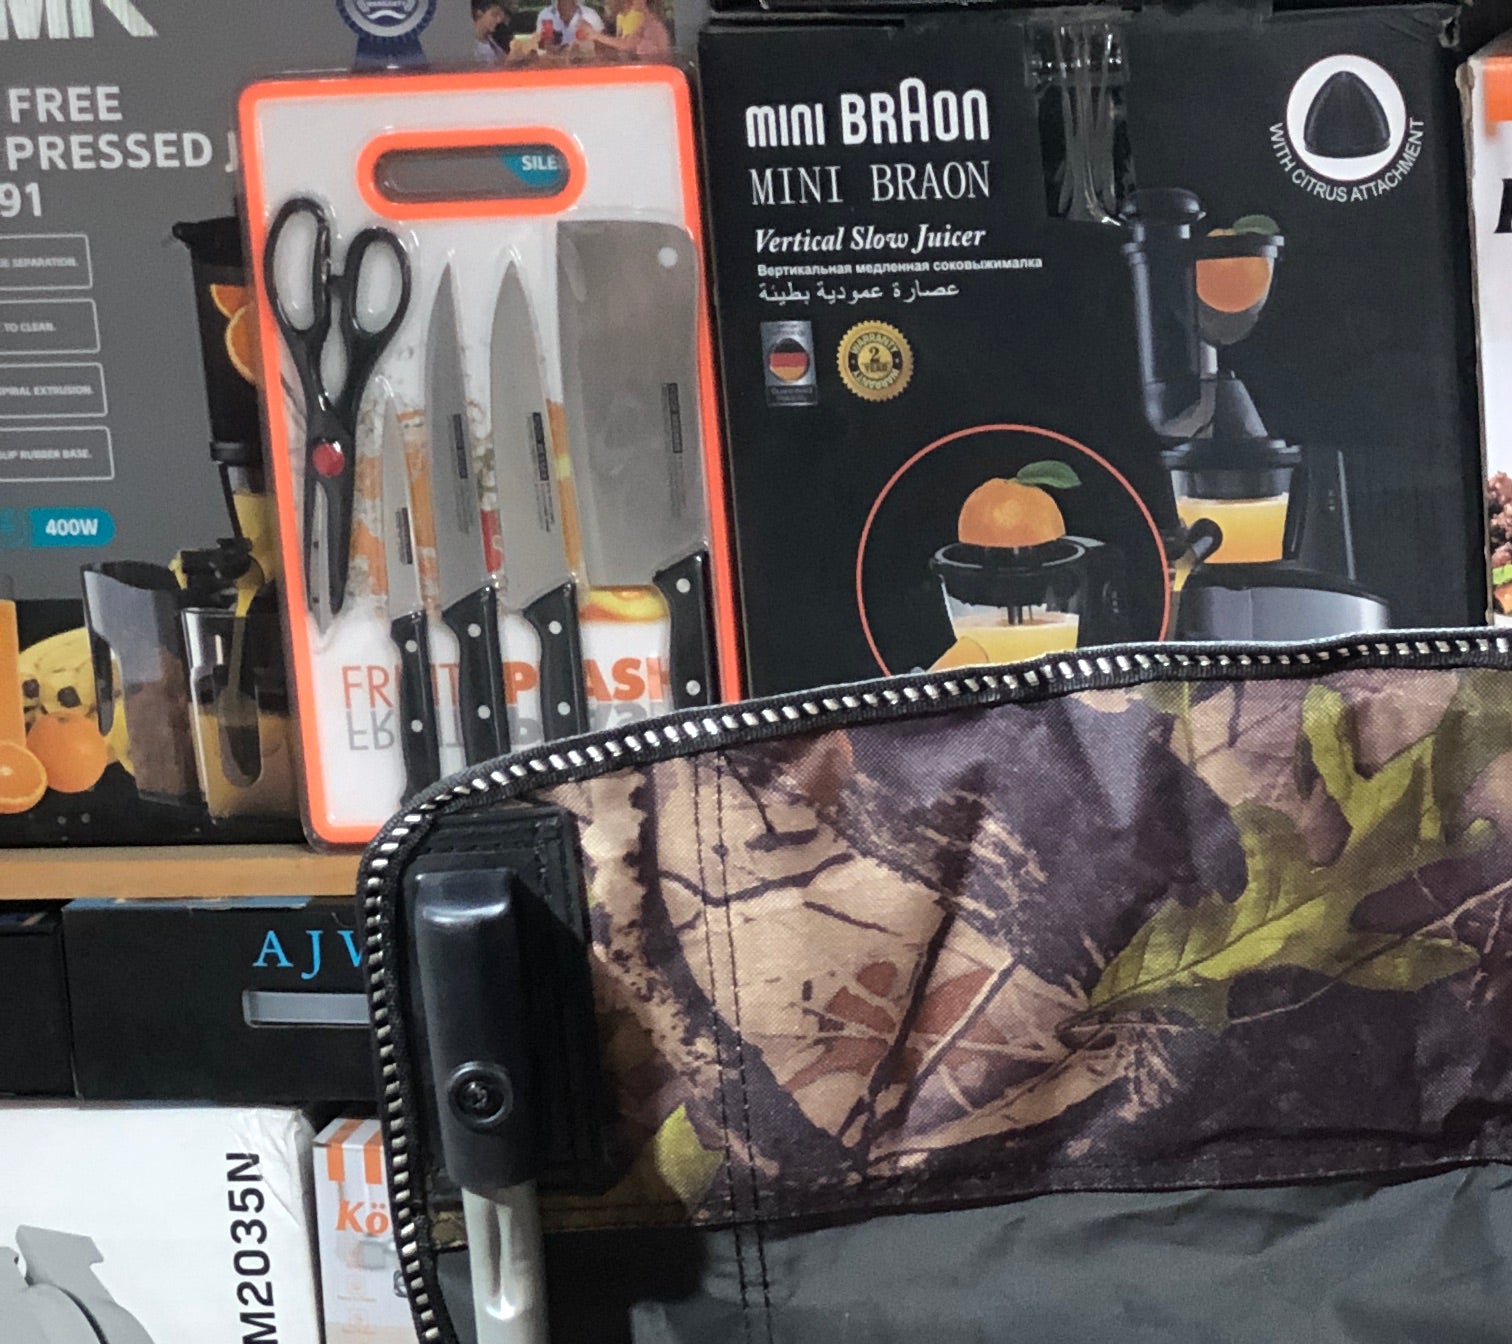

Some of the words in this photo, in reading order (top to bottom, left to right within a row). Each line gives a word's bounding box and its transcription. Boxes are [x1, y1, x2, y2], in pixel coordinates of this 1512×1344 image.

[8, 86, 122, 123] FREE
[6, 132, 212, 171] PRESSED
[1269, 122, 1293, 173] WITH
[1291, 168, 1347, 203] CITRUS
[1350, 117, 1425, 202] ATTACHMENT
[749, 166, 843, 205] MINI
[870, 161, 991, 202] BRAON
[755, 226, 844, 252] Vertical
[851, 225, 908, 250] Slow
[912, 223, 986, 254] Juicer
[758, 264, 852, 277] Вертикальная
[868, 347, 880, 361] 2
[45, 518, 99, 536] 400W
